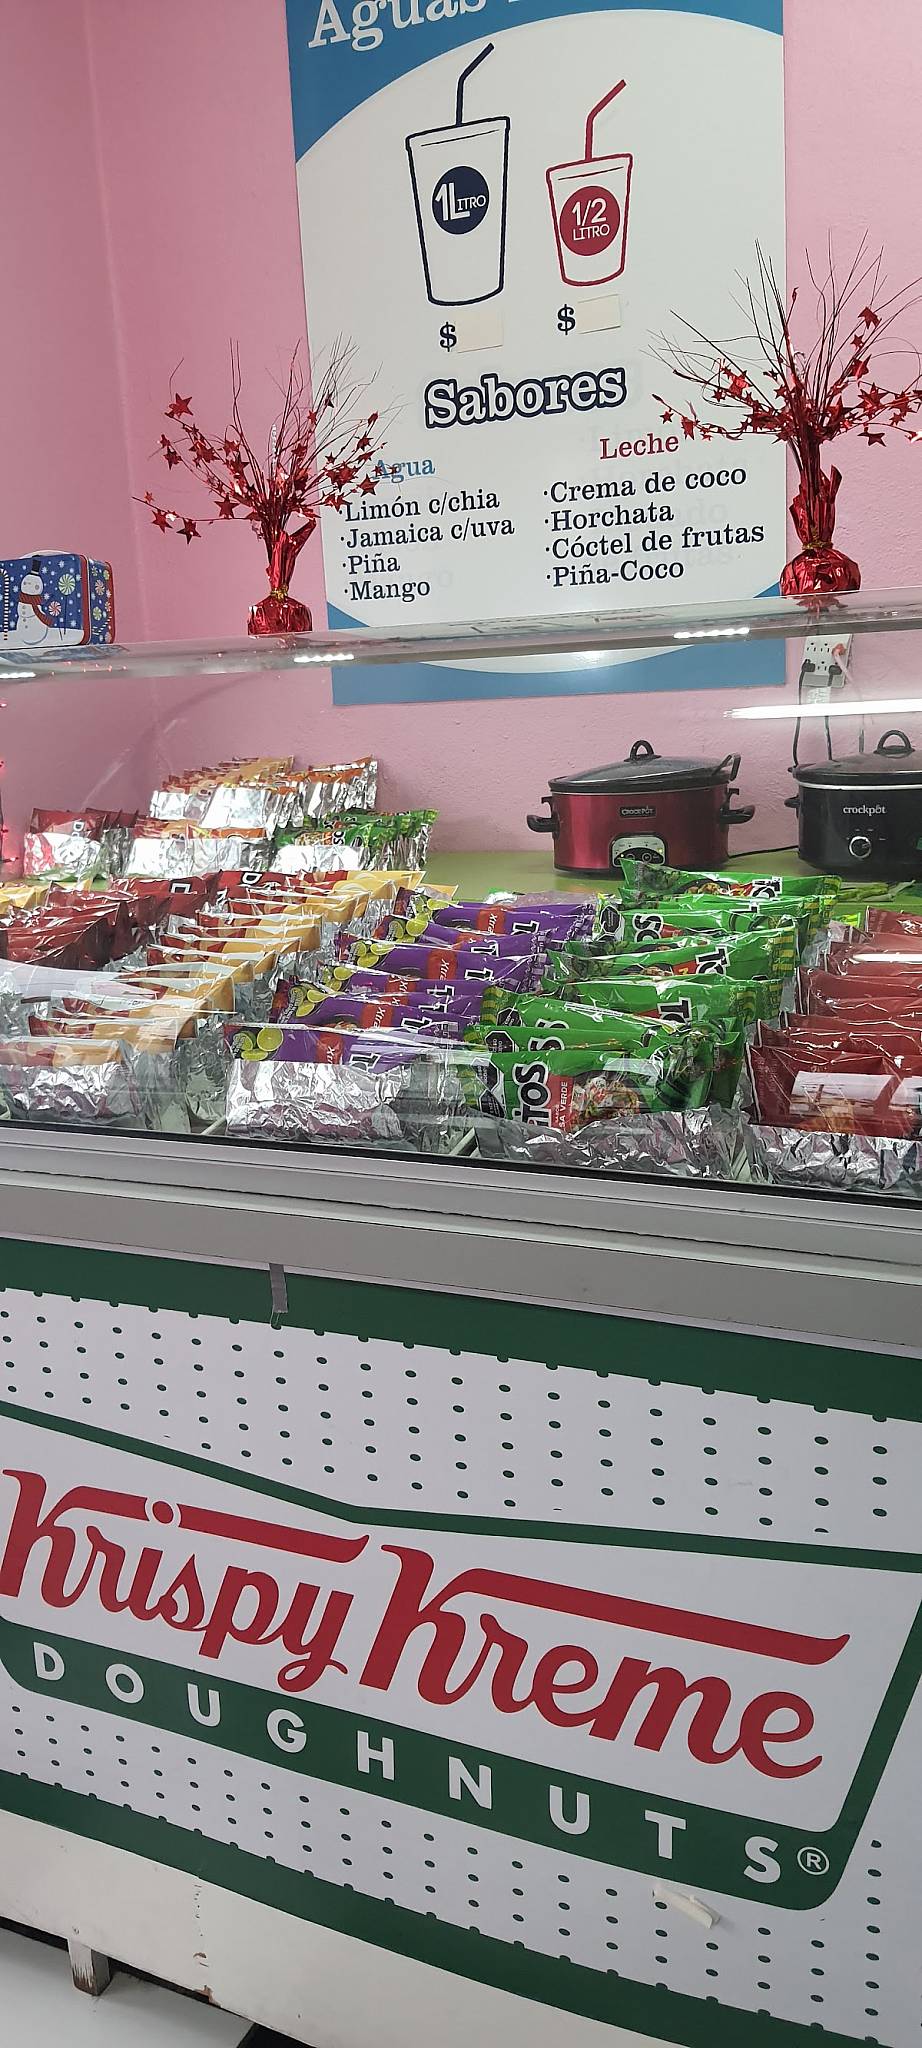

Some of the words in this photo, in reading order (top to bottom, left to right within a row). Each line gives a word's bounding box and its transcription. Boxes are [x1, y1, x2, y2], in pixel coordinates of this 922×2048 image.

[571, 197, 608, 227] 1/2
[572, 222, 611, 242] LITRO
[557, 304, 576, 335] $
[439, 321, 458, 352] $
[425, 366, 626, 429] Sabores
[599, 432, 680, 460] Leche
[371, 459, 436, 484] Agua
[549, 478, 637, 504] Crema
[644, 472, 676, 494] de
[685, 467, 747, 490] coco
[345, 496, 420, 523] Limón
[428, 489, 500, 519] c/chia
[550, 502, 675, 532] Horchata
[346, 524, 443, 548] Jamaica
[451, 516, 515, 541] c/uva
[551, 533, 633, 560] Cóctel
[641, 530, 672, 552] de
[680, 525, 765, 549] frutas
[347, 555, 401, 576] Piña
[553, 562, 685, 588] Piña-Coco
[349, 580, 431, 603] Mango
[560, 1082, 568, 1111] VERDE
[0, 1468, 370, 1694] Krispy
[358, 1544, 851, 1779] Kreme
[33, 1641, 782, 1885] DOUGHNUTS
